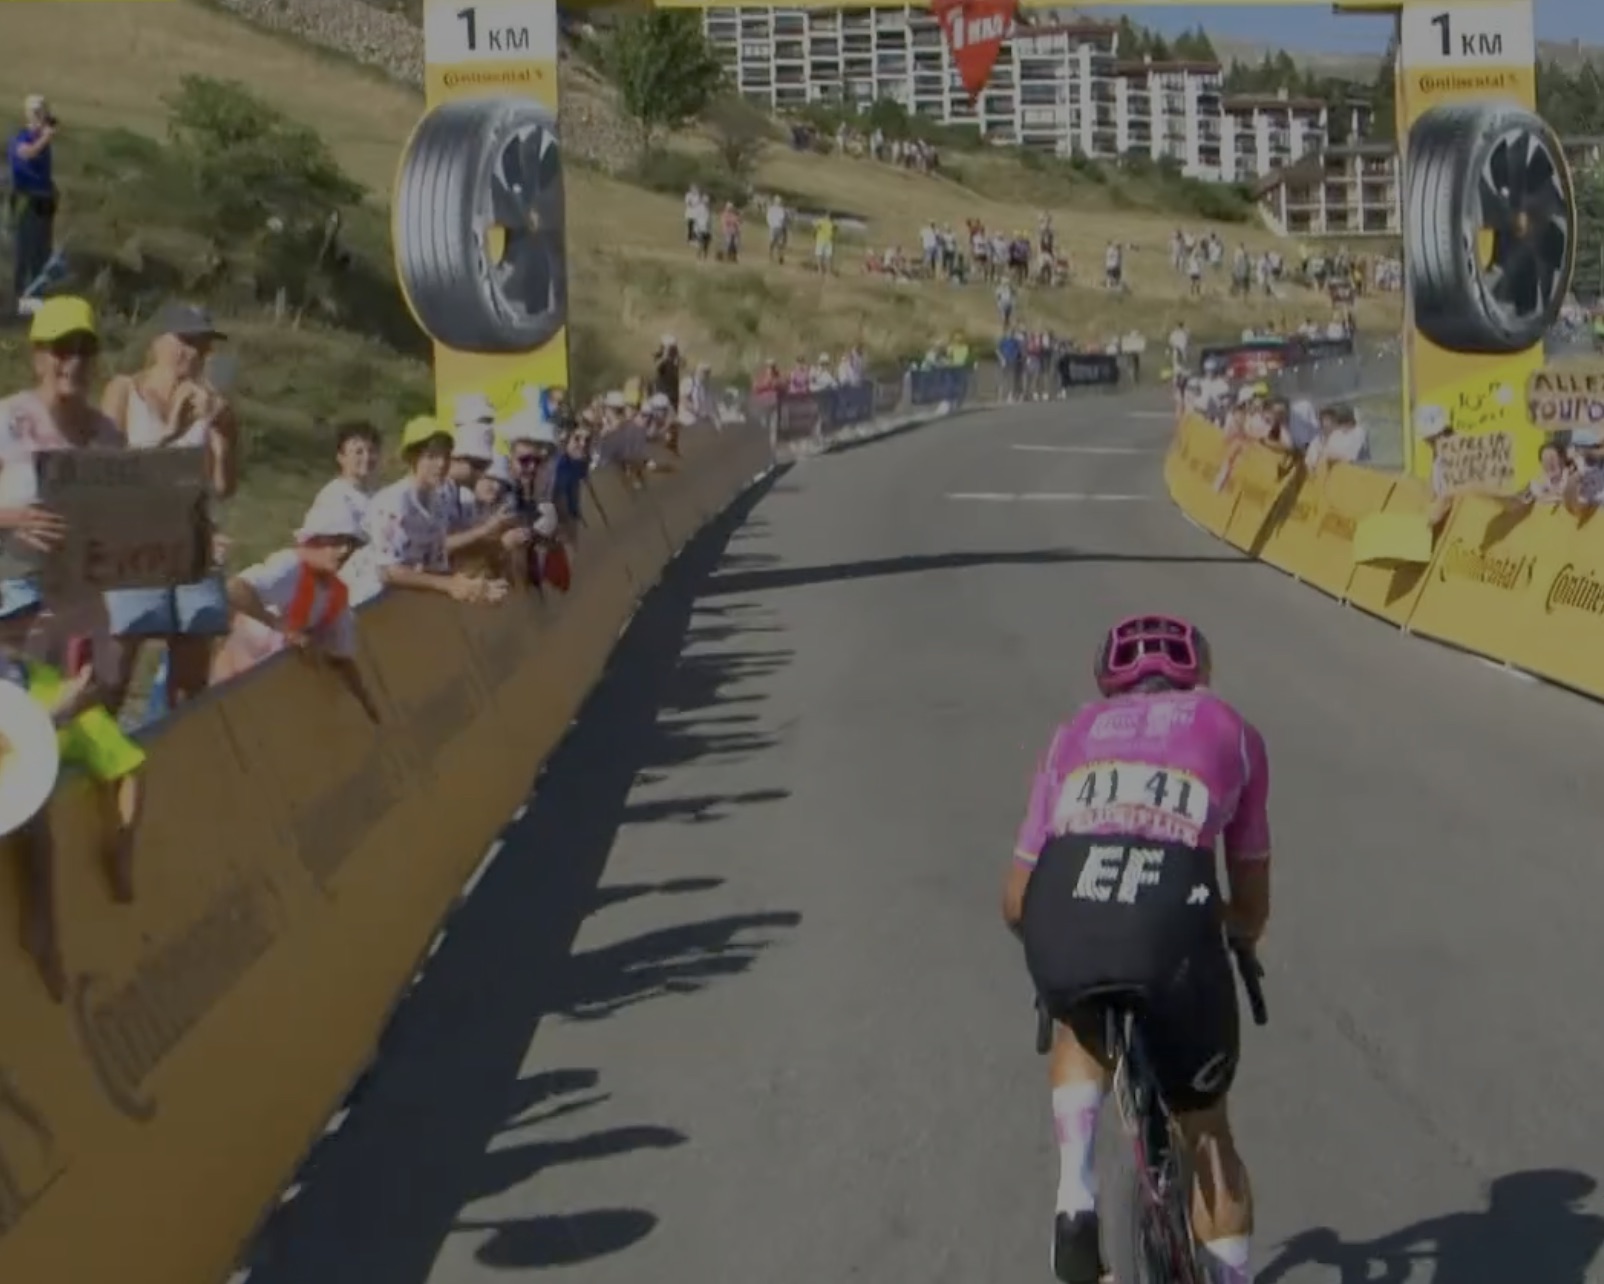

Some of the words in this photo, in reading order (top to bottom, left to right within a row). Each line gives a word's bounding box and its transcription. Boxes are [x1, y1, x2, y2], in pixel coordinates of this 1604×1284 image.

[457, 7, 477, 51] 1
[489, 27, 530, 52] KM
[1430, 12, 1451, 57] 1
[1461, 32, 1502, 57] KM
[1418, 72, 1505, 93] Continental
[1076, 768, 1119, 808] 41
[1145, 769, 1193, 820] 41
[1072, 843, 1166, 905] EF
